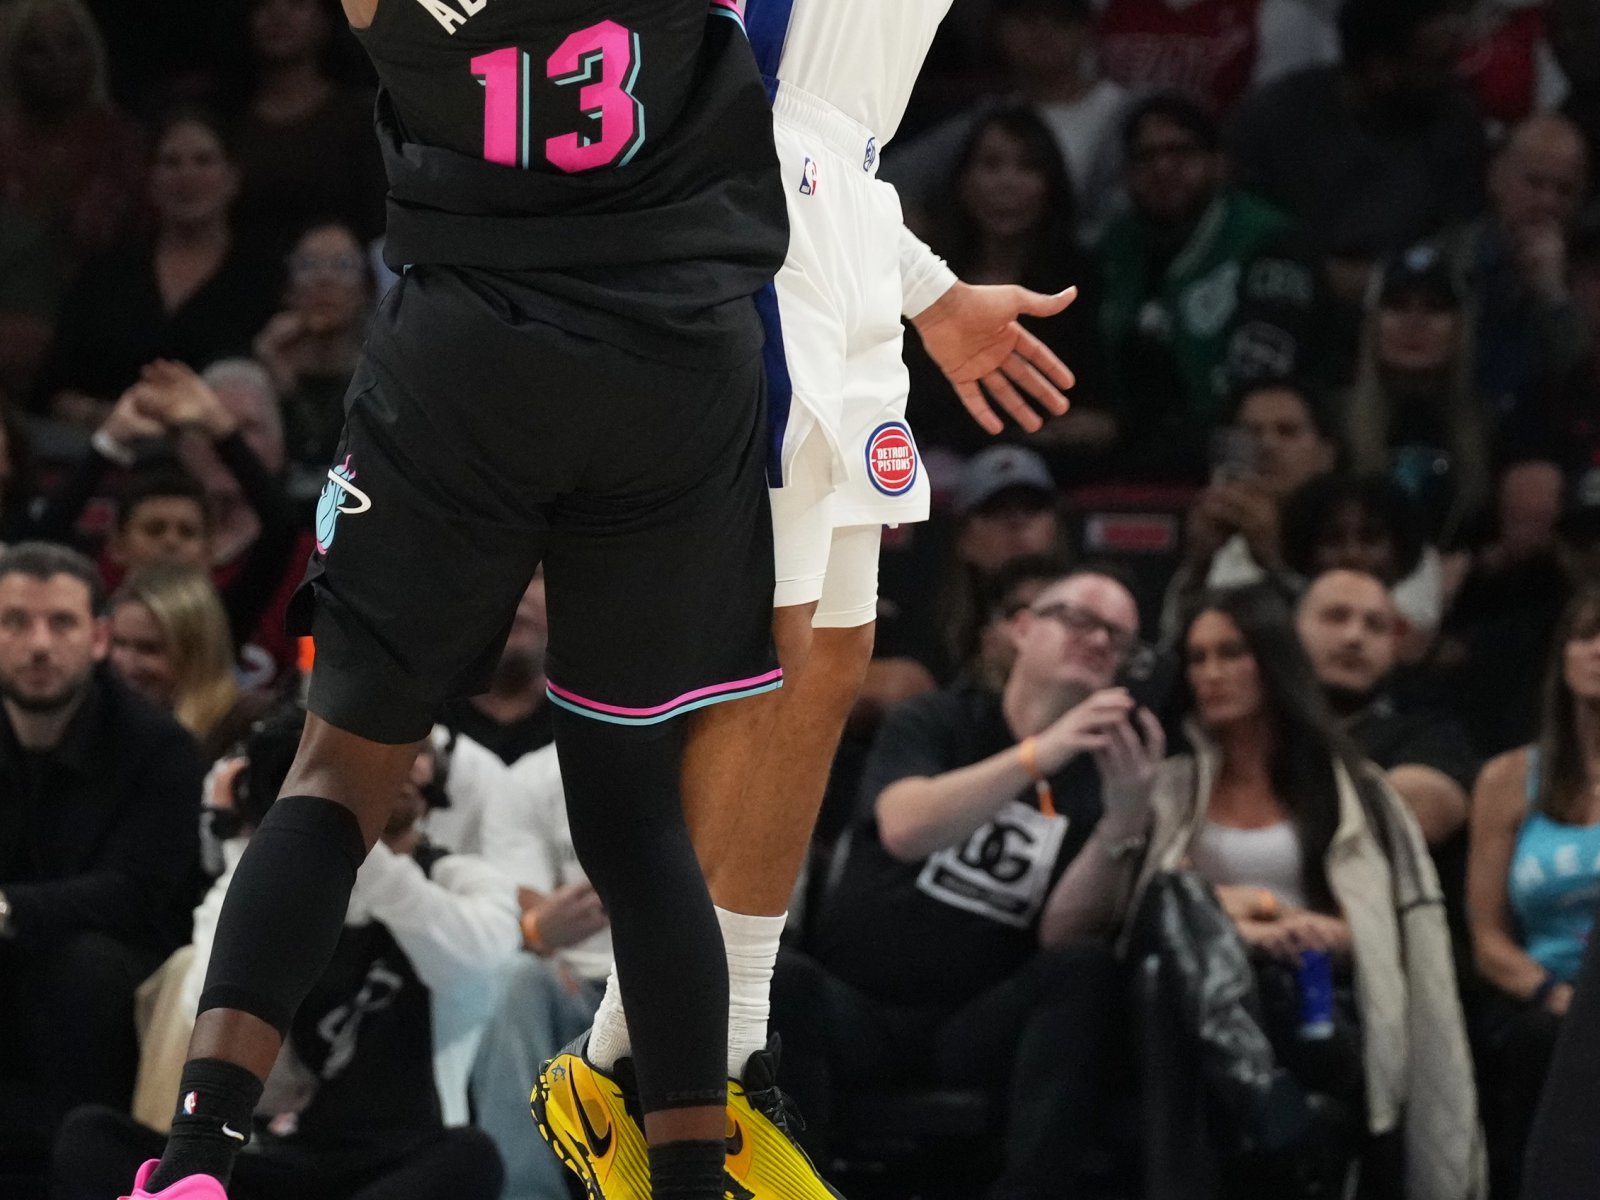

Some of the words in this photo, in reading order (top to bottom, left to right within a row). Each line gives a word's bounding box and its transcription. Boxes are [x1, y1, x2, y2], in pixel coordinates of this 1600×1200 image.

[470, 19, 646, 174] 13
[876, 446, 909, 460] DETROIT
[877, 458, 911, 472] PISTONS
